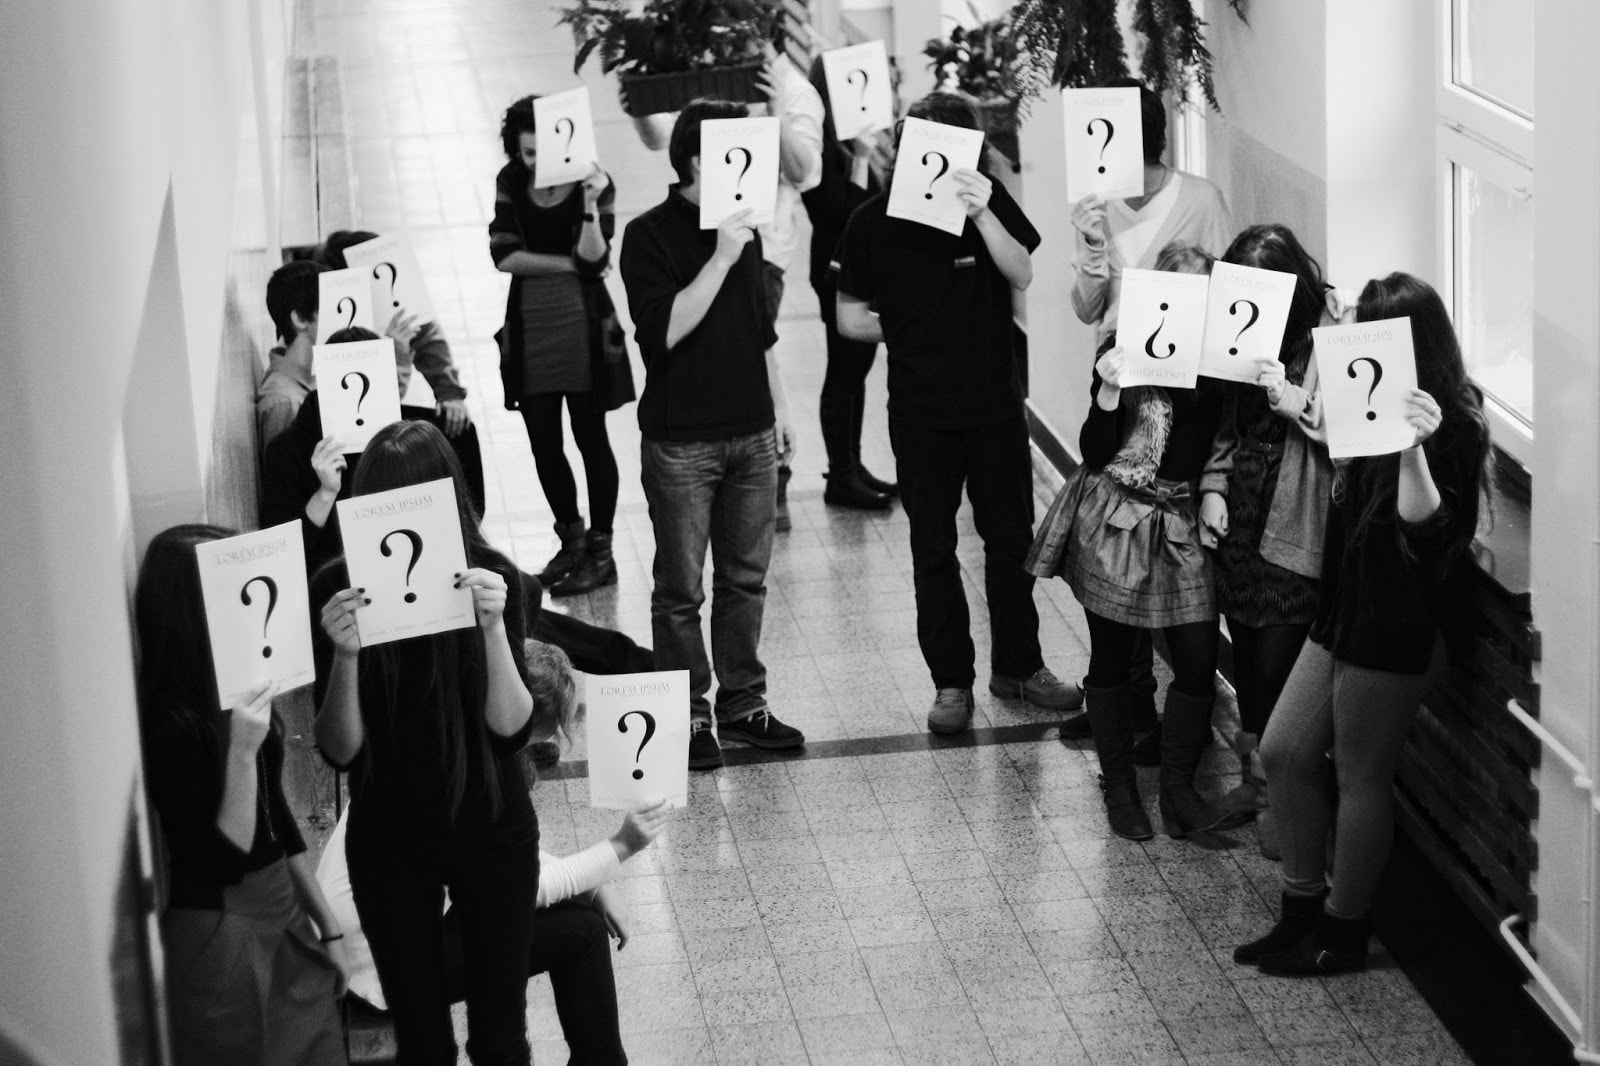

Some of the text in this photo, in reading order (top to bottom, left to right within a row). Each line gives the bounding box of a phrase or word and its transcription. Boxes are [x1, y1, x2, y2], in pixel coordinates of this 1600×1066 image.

[354, 495, 433, 520] LOREM IPSUM
[215, 538, 287, 566] LOREM IPSUM
[600, 682, 671, 696] LOREM IPSUM
